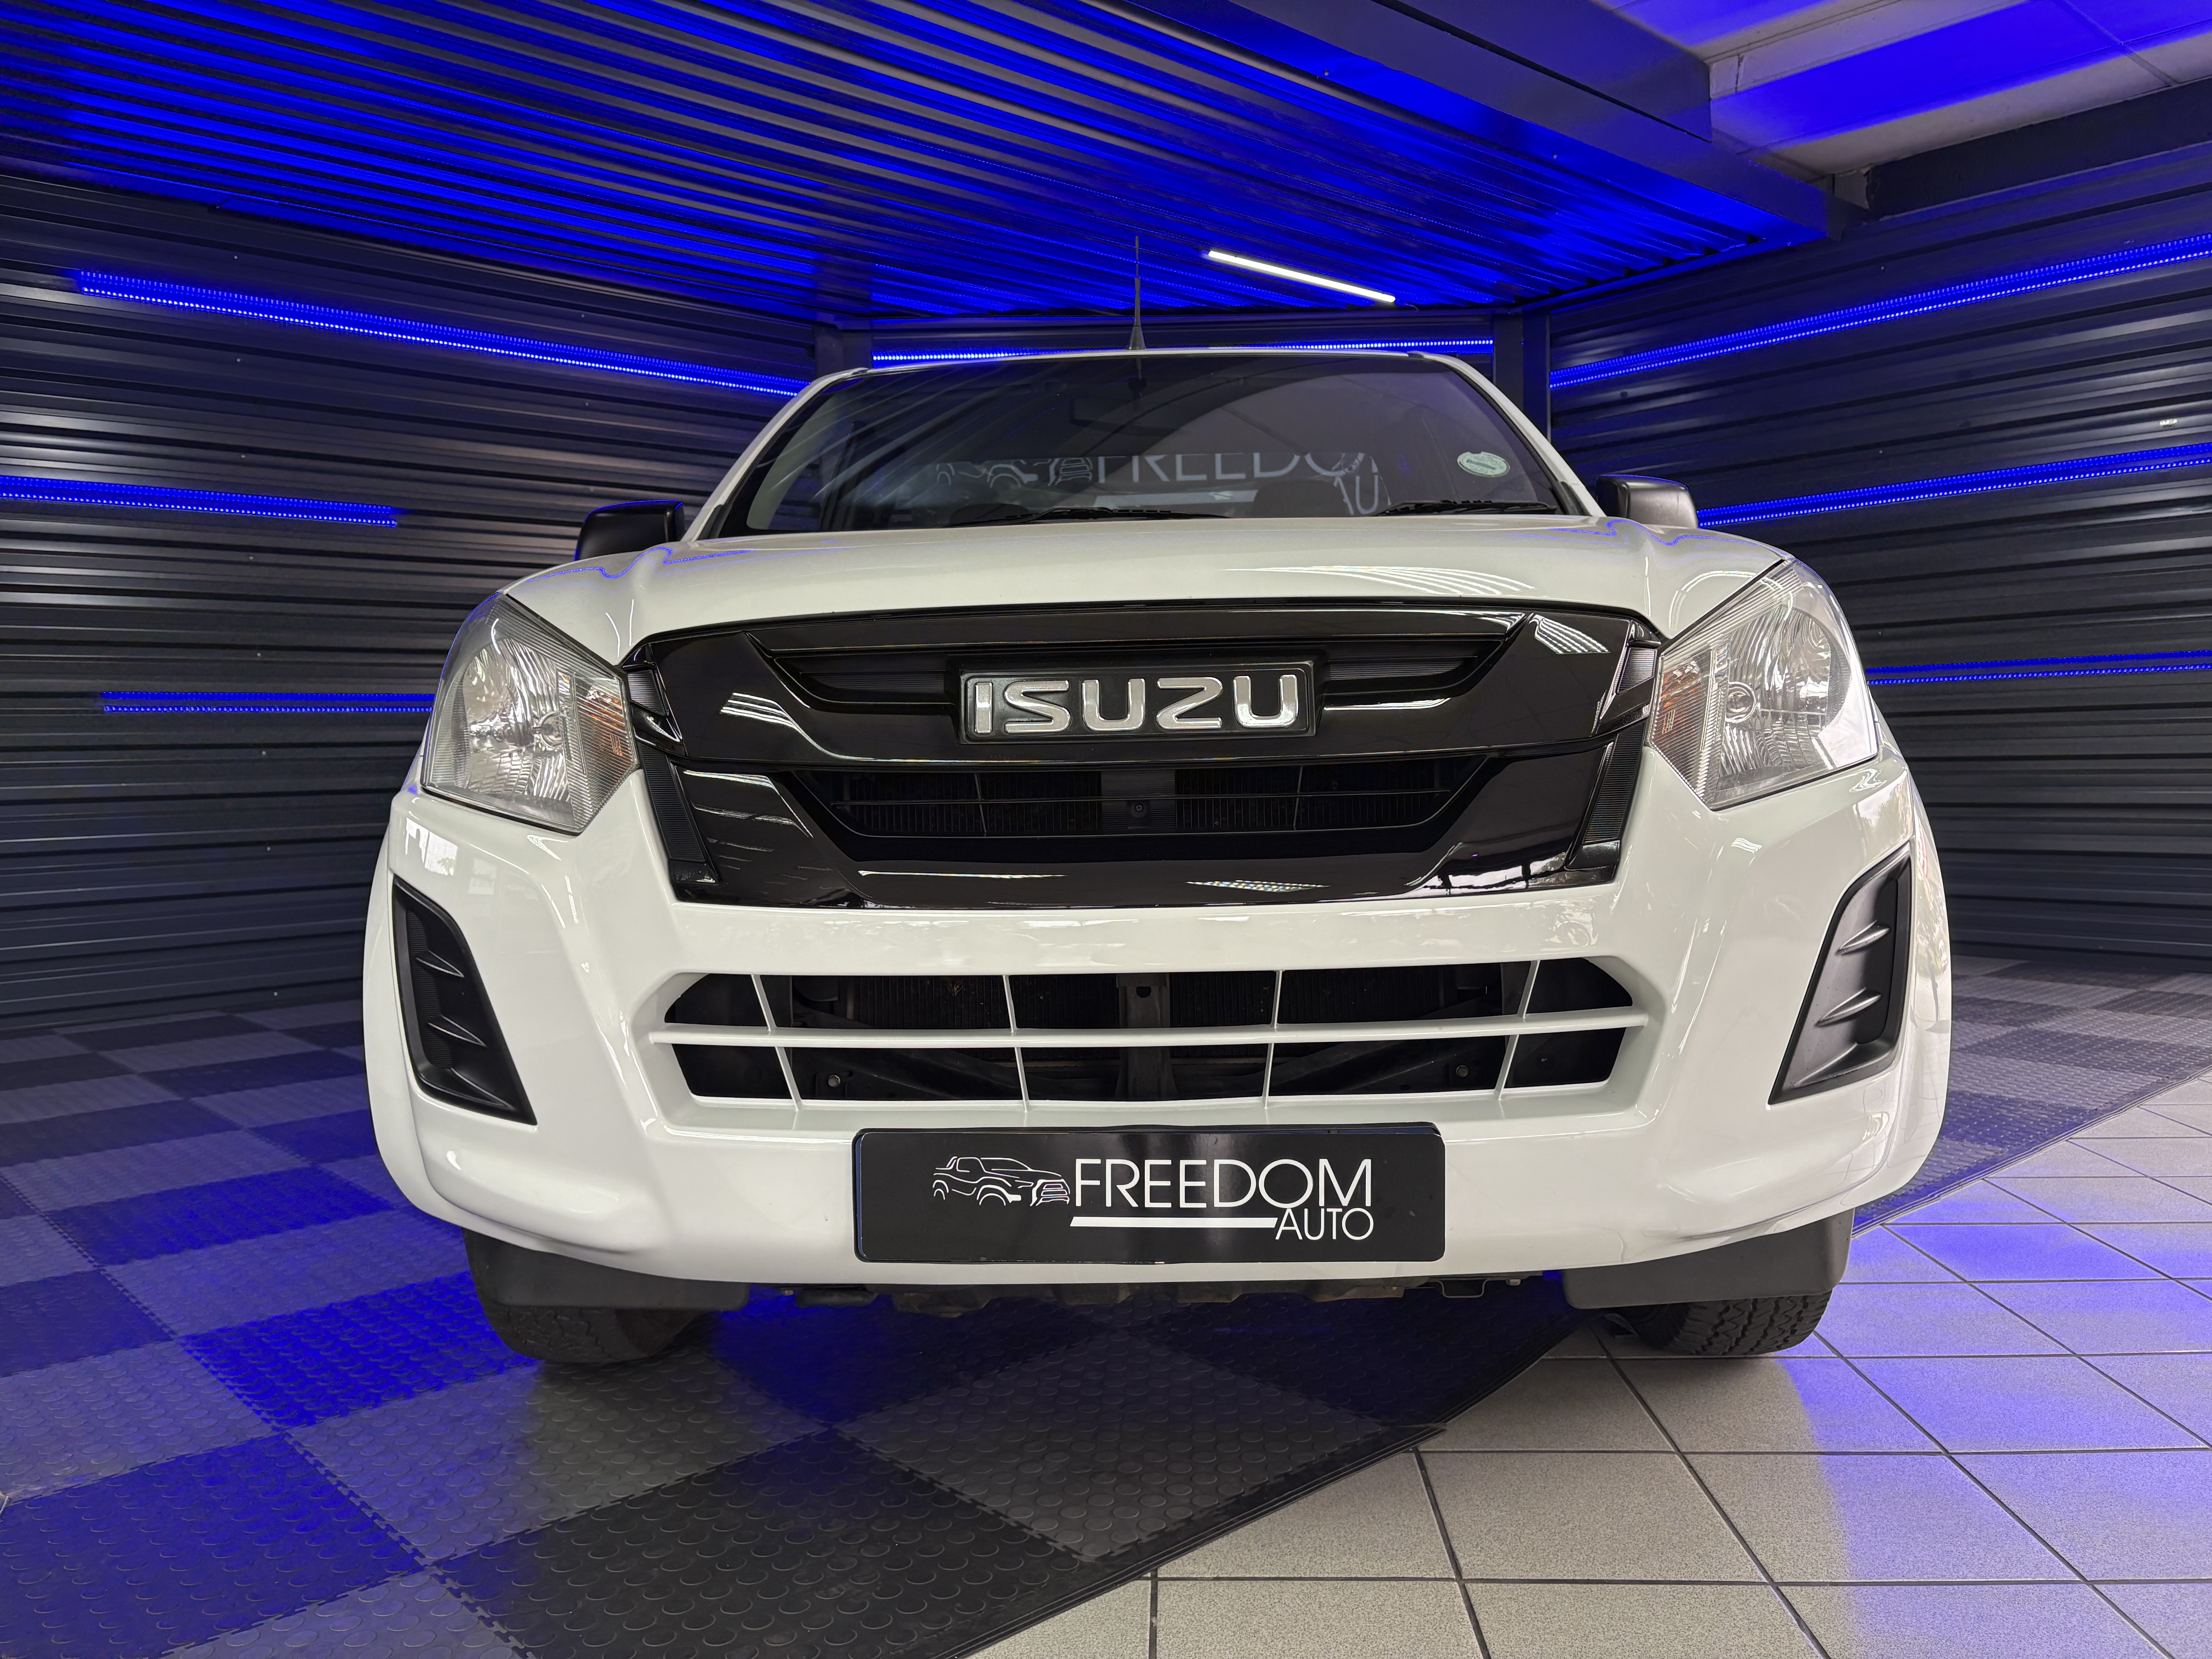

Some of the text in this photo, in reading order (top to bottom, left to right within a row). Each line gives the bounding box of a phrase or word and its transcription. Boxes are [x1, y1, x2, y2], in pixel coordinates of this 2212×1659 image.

[974, 674, 1299, 734] ISUZU
[1075, 1158, 1372, 1209] FREEDOM
[1275, 1207, 1374, 1241] AUTO
